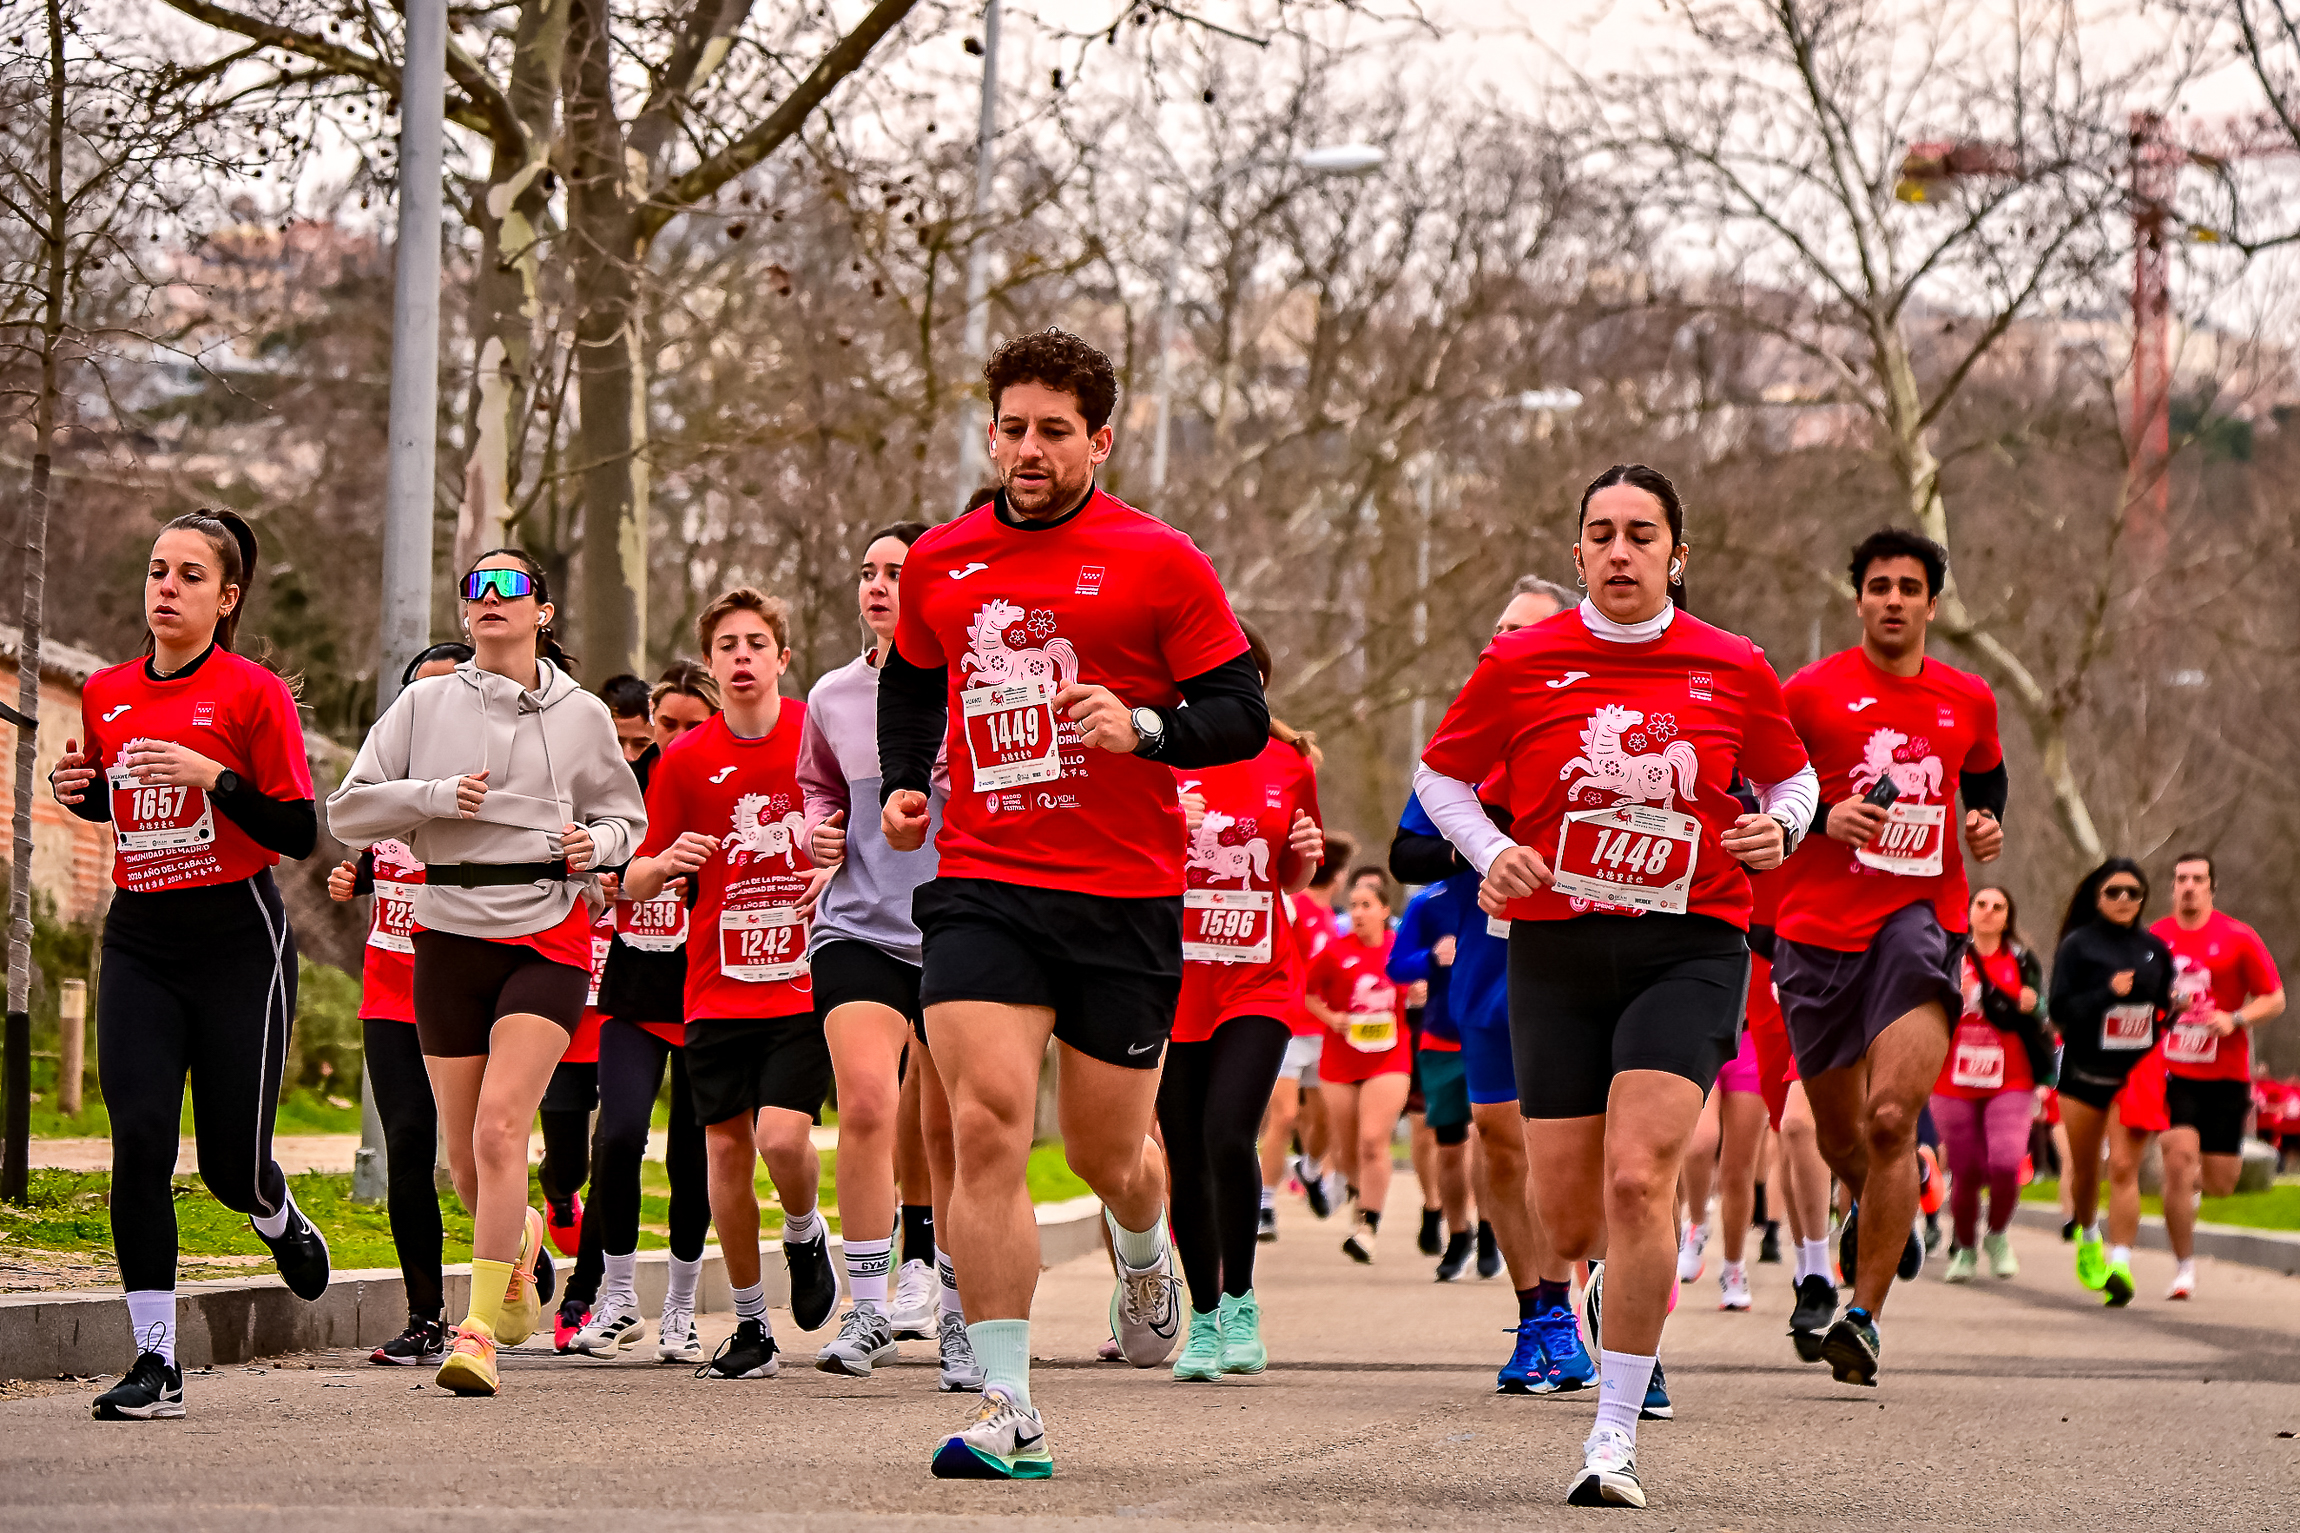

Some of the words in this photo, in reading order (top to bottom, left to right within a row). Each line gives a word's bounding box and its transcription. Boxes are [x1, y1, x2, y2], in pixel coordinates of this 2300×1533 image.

[986, 707, 1039, 753] 1449
[132, 786, 188, 820] 1657
[1057, 794, 1075, 803] KDH
[165, 847, 177, 855] DE
[1878, 822, 1930, 851] 1070
[1590, 829, 1674, 875] 1448
[127, 871, 142, 881] 2026
[143, 867, 160, 879] AÑO
[160, 864, 177, 874] DEL
[177, 856, 217, 870] CABALLO
[167, 873, 183, 884] 2026
[385, 900, 415, 929] 223
[629, 901, 677, 928] 2538
[1199, 909, 1256, 938] 1596
[740, 926, 792, 957] 1242
